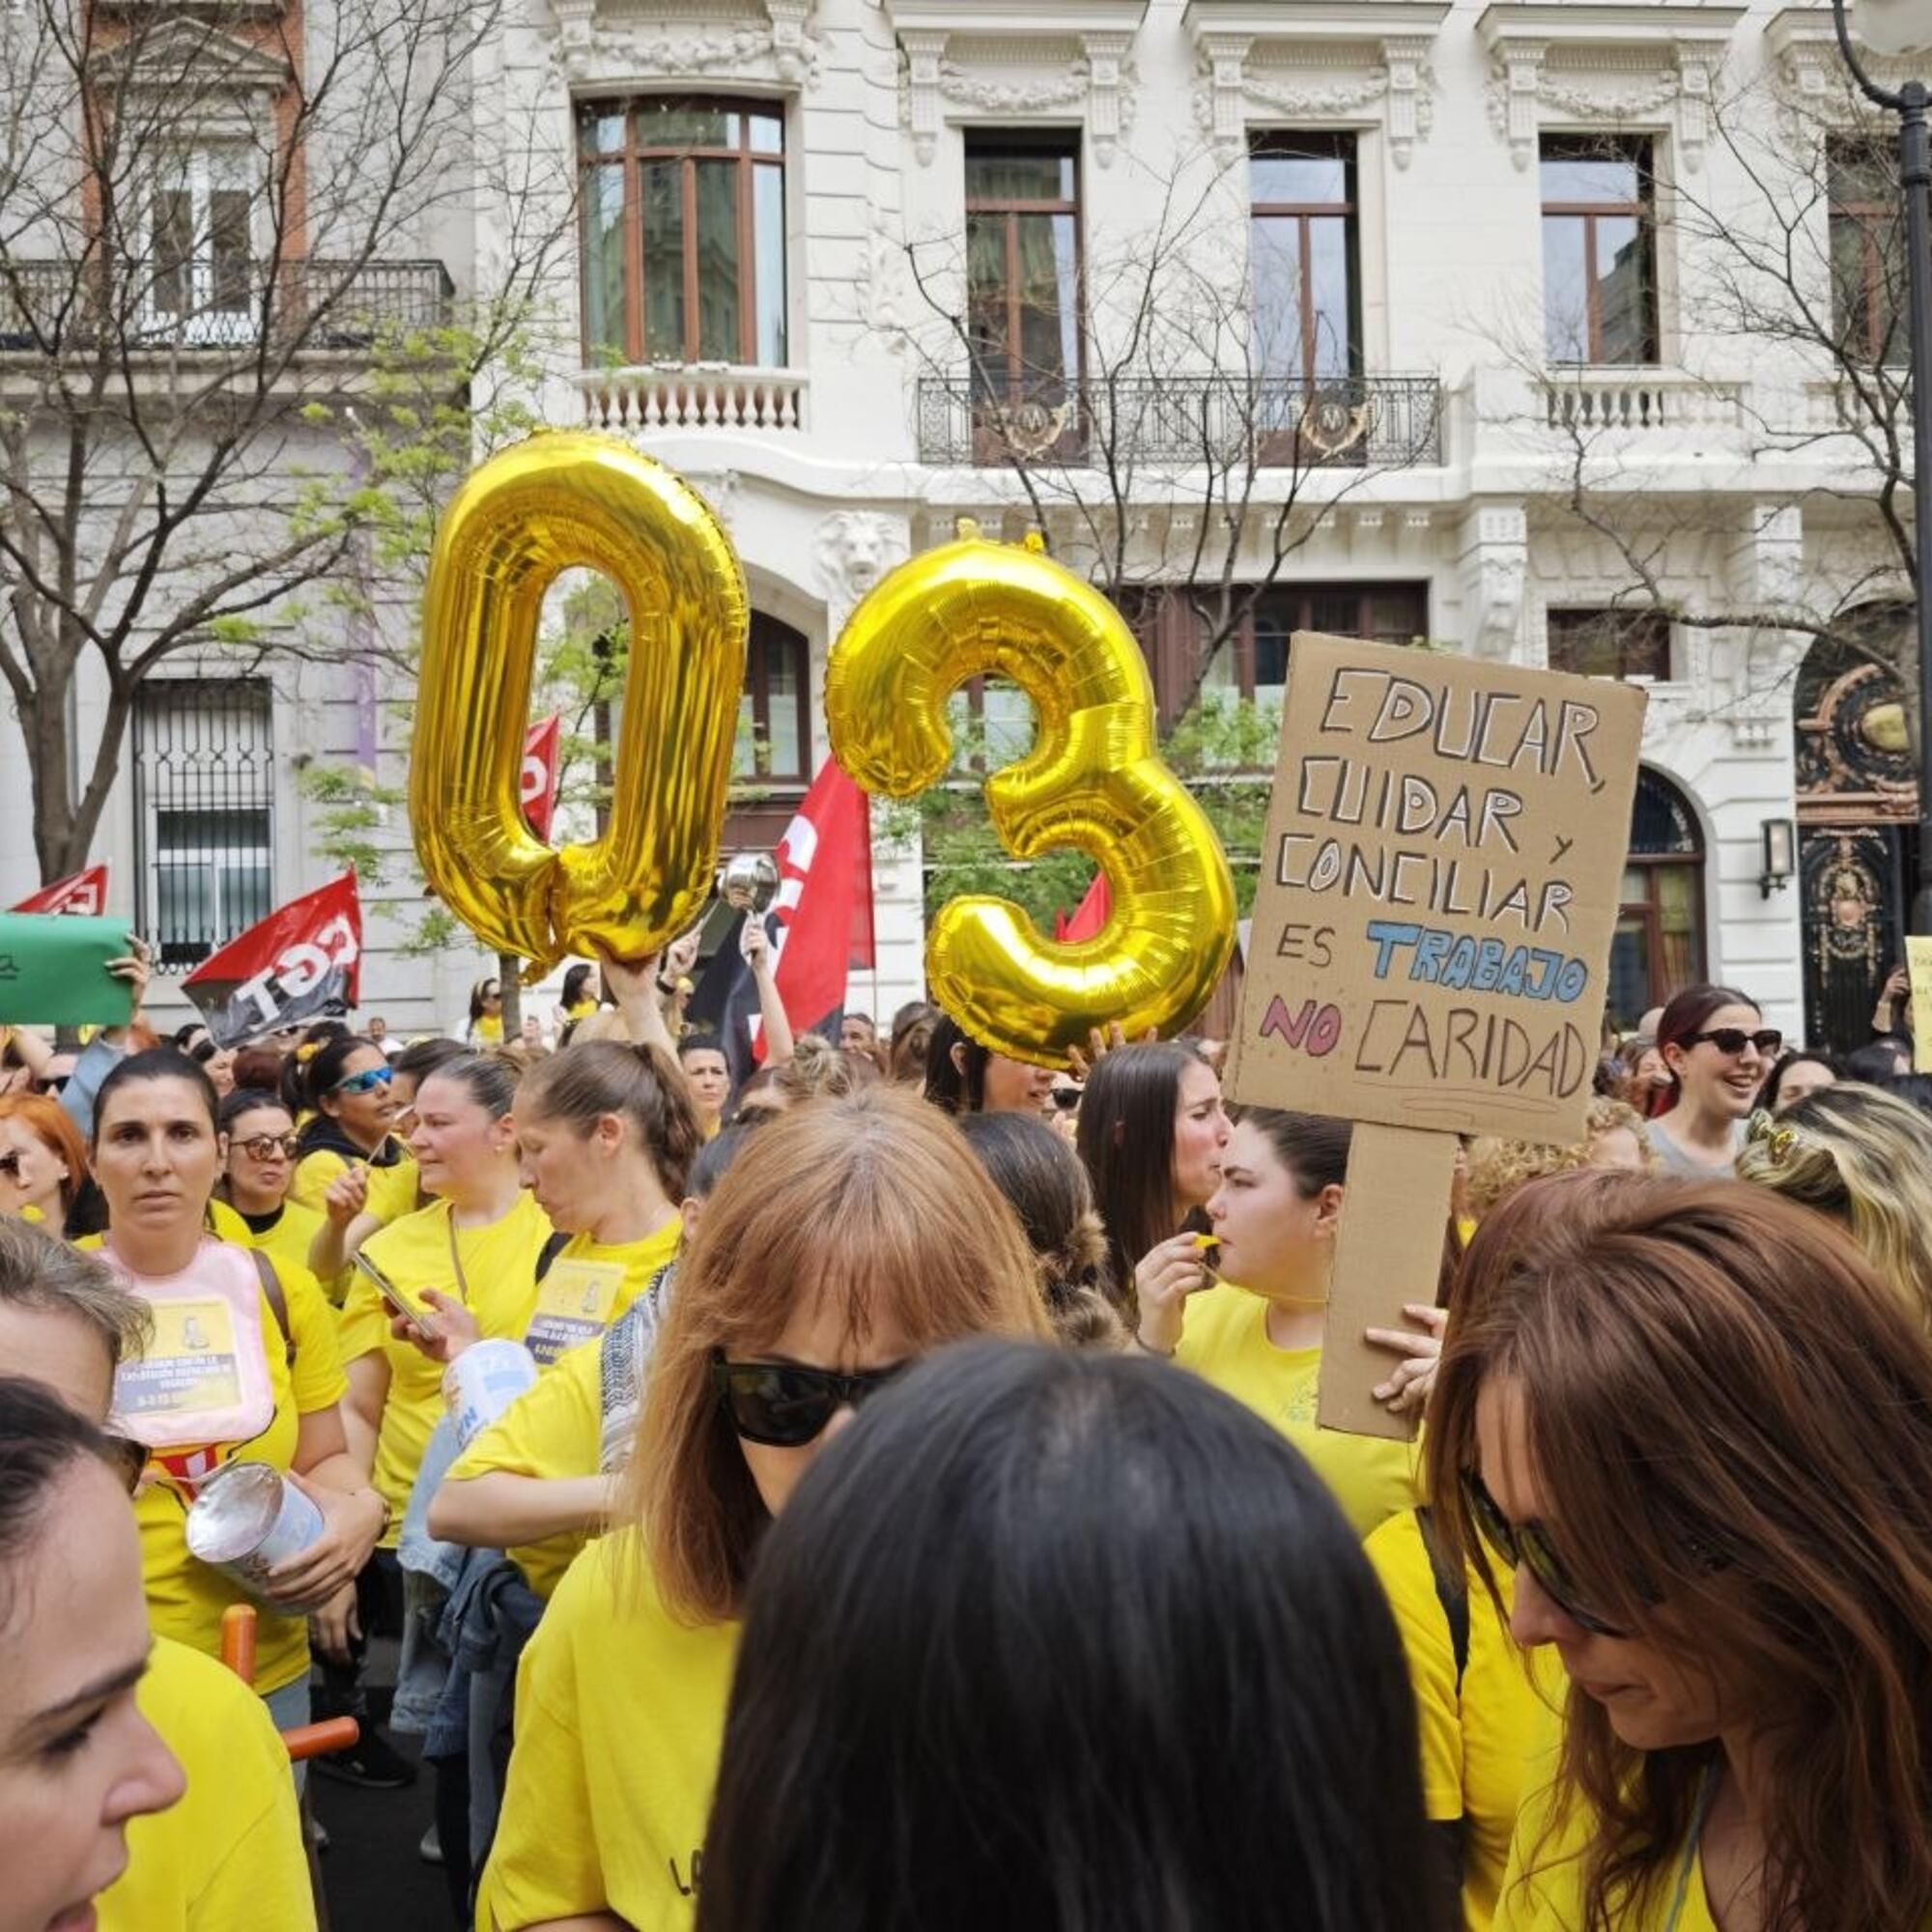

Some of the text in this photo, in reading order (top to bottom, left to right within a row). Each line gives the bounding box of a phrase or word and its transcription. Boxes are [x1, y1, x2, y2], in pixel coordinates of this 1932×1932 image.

[1321, 668, 1605, 794] EDUCAR,
[824, 533, 1237, 1069] 3
[1298, 755, 1523, 854] CUIDAR
[1277, 833, 1574, 934] CONCILIAR
[1276, 920, 1589, 1003] ES TRABAJO
[1259, 994, 1587, 1099] NO CARIDAD
